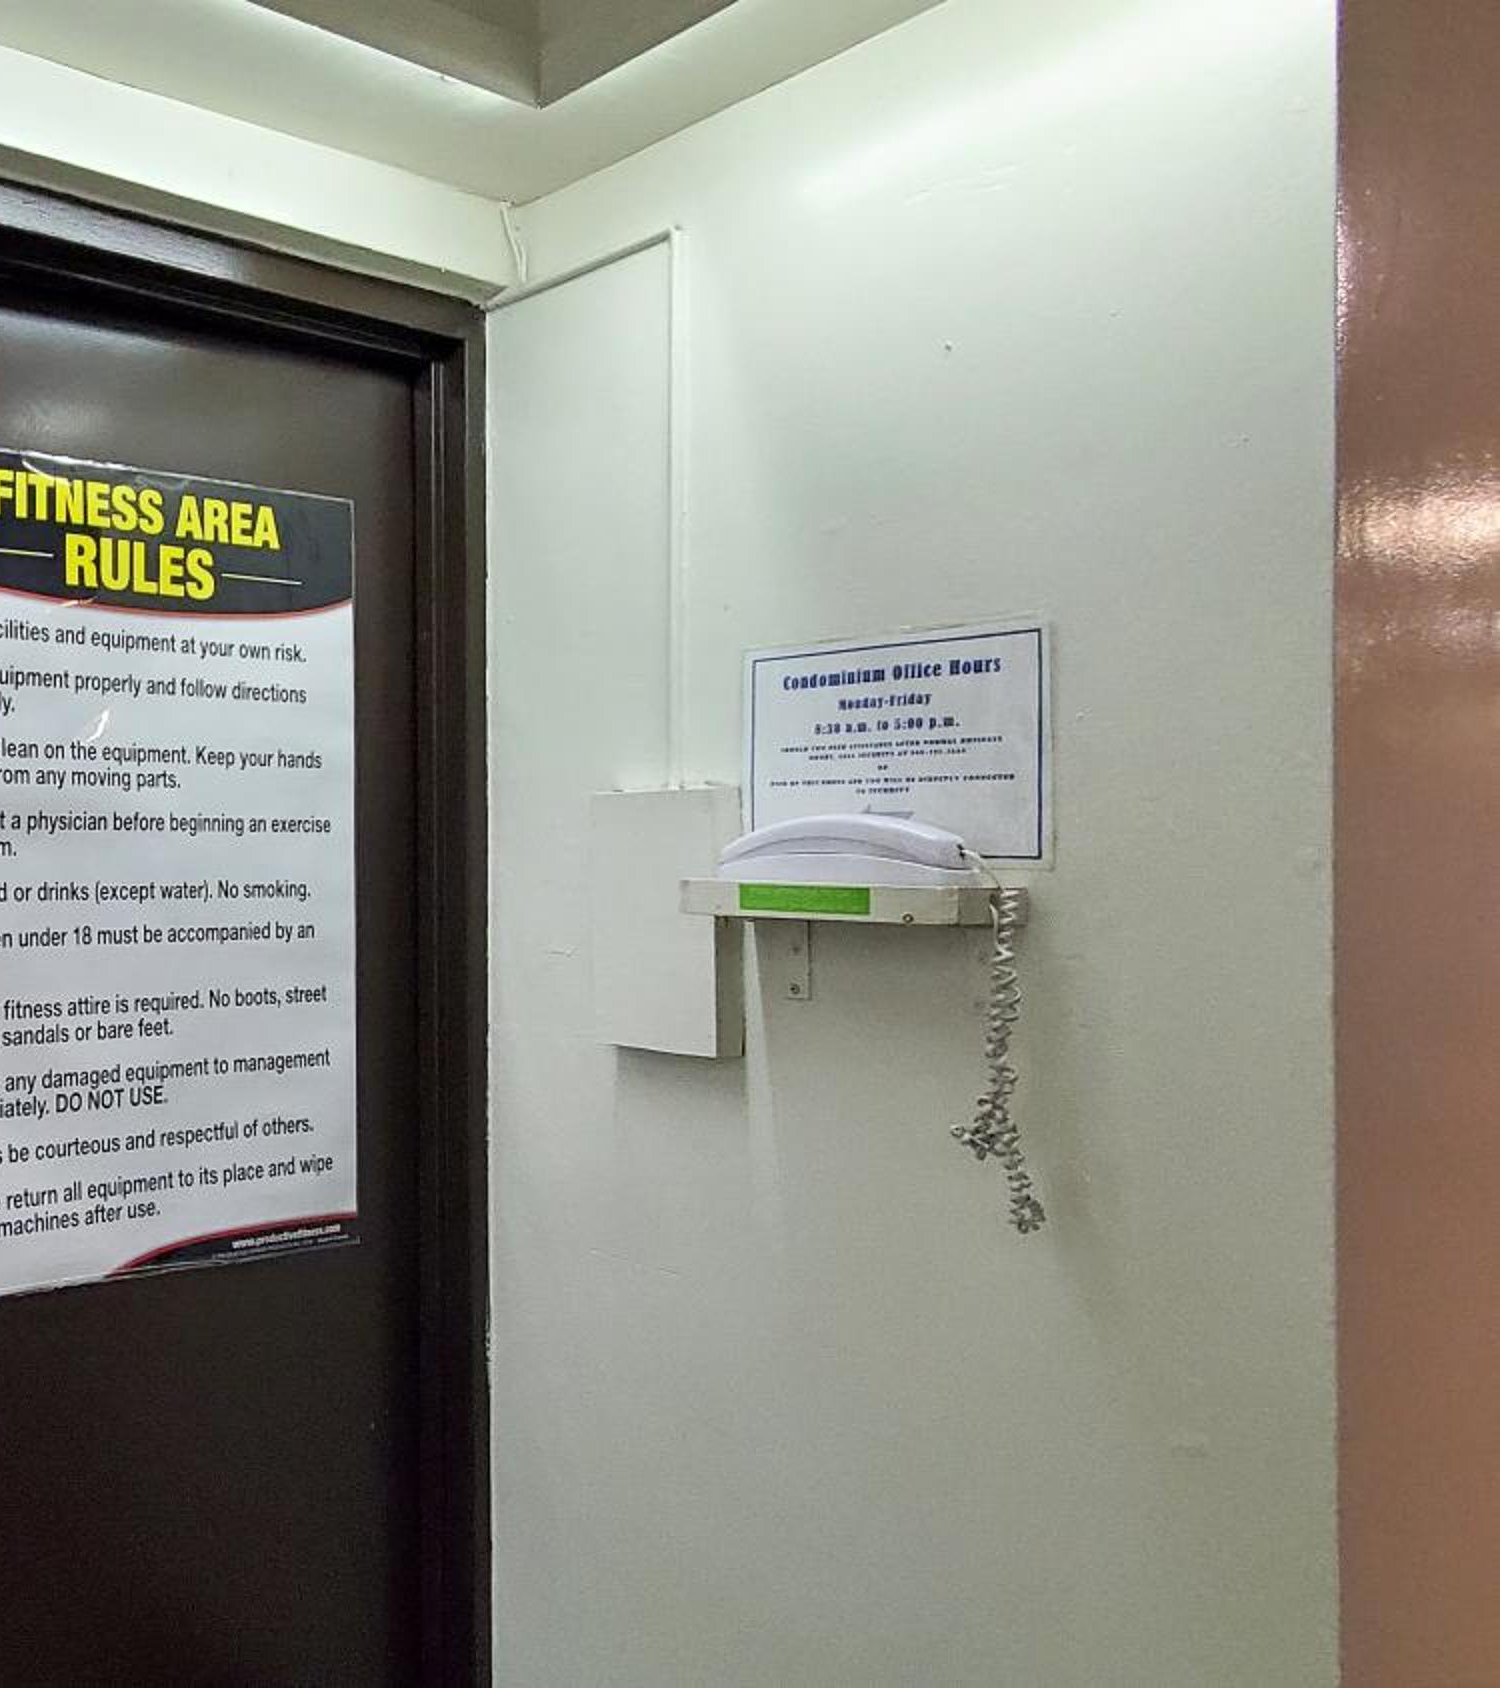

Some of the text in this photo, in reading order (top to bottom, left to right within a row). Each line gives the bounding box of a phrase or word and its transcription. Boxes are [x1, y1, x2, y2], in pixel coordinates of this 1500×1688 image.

[175, 494, 281, 551] AREA
[65, 533, 215, 599] RULES
[55, 625, 86, 645] and
[90, 628, 176, 654] equipment
[180, 636, 196, 654] at
[199, 641, 235, 659] your
[238, 643, 271, 660] own
[274, 643, 306, 662] risk.
[74, 673, 141, 698] properly
[145, 677, 176, 696] and
[179, 677, 227, 699] follow
[231, 681, 306, 704] directions
[783, 657, 1001, 691] Condominium Office Hours
[877, 719, 889, 731] to
[893, 718, 924, 730] 5:00
[1, 738, 39, 758] lean
[43, 743, 65, 759] on
[69, 740, 97, 761] the
[101, 745, 191, 767] equipment.
[195, 745, 235, 770] Keep
[239, 752, 274, 770] your
[277, 749, 322, 769] hands
[35, 769, 66, 790] any
[71, 770, 131, 792] moving
[135, 769, 181, 792] parts.
[10, 814, 21, 830] a
[25, 809, 108, 835] physician
[112, 811, 165, 831] before
[169, 812, 244, 837] beginning
[248, 817, 266, 833] an
[271, 815, 331, 833] exercise
[13, 886, 33, 902] or
[37, 881, 90, 901] drinks
[94, 880, 155, 905] (except
[159, 879, 213, 903] water).
[217, 879, 239, 899] No
[243, 879, 311, 902] smoking.
[18, 926, 68, 948] under
[73, 925, 92, 945] 18
[97, 925, 138, 945] must
[143, 923, 162, 943] be
[167, 921, 270, 944] accompanied
[275, 920, 293, 943] by
[297, 924, 314, 939] an
[3, 999, 63, 1021] fitness
[67, 996, 111, 1016] attire
[115, 998, 129, 1013] is
[133, 990, 204, 1015] required.
[209, 989, 231, 1008] No
[234, 987, 281, 1008] boots,
[285, 985, 326, 1004] street
[4, 1074, 37, 1095] any
[41, 1063, 121, 1090] damaged
[125, 1057, 209, 1085] equipment
[213, 1057, 229, 1075] to
[233, 1048, 330, 1074] management
[7, 1143, 30, 1163] be
[34, 1137, 120, 1160] courteous
[125, 1129, 155, 1151] and
[159, 1121, 238, 1149] respectful
[243, 1119, 258, 1138] of
[261, 1117, 314, 1136] others.
[6, 1188, 58, 1210] return
[63, 1181, 82, 1203] all
[87, 1171, 174, 1202] equipment
[177, 1169, 194, 1187] to
[198, 1167, 218, 1185] its
[222, 1163, 264, 1188] place
[267, 1156, 295, 1178] and
[299, 1156, 333, 1176] wipe
[83, 1203, 123, 1226] after
[127, 1201, 160, 1219] use.
